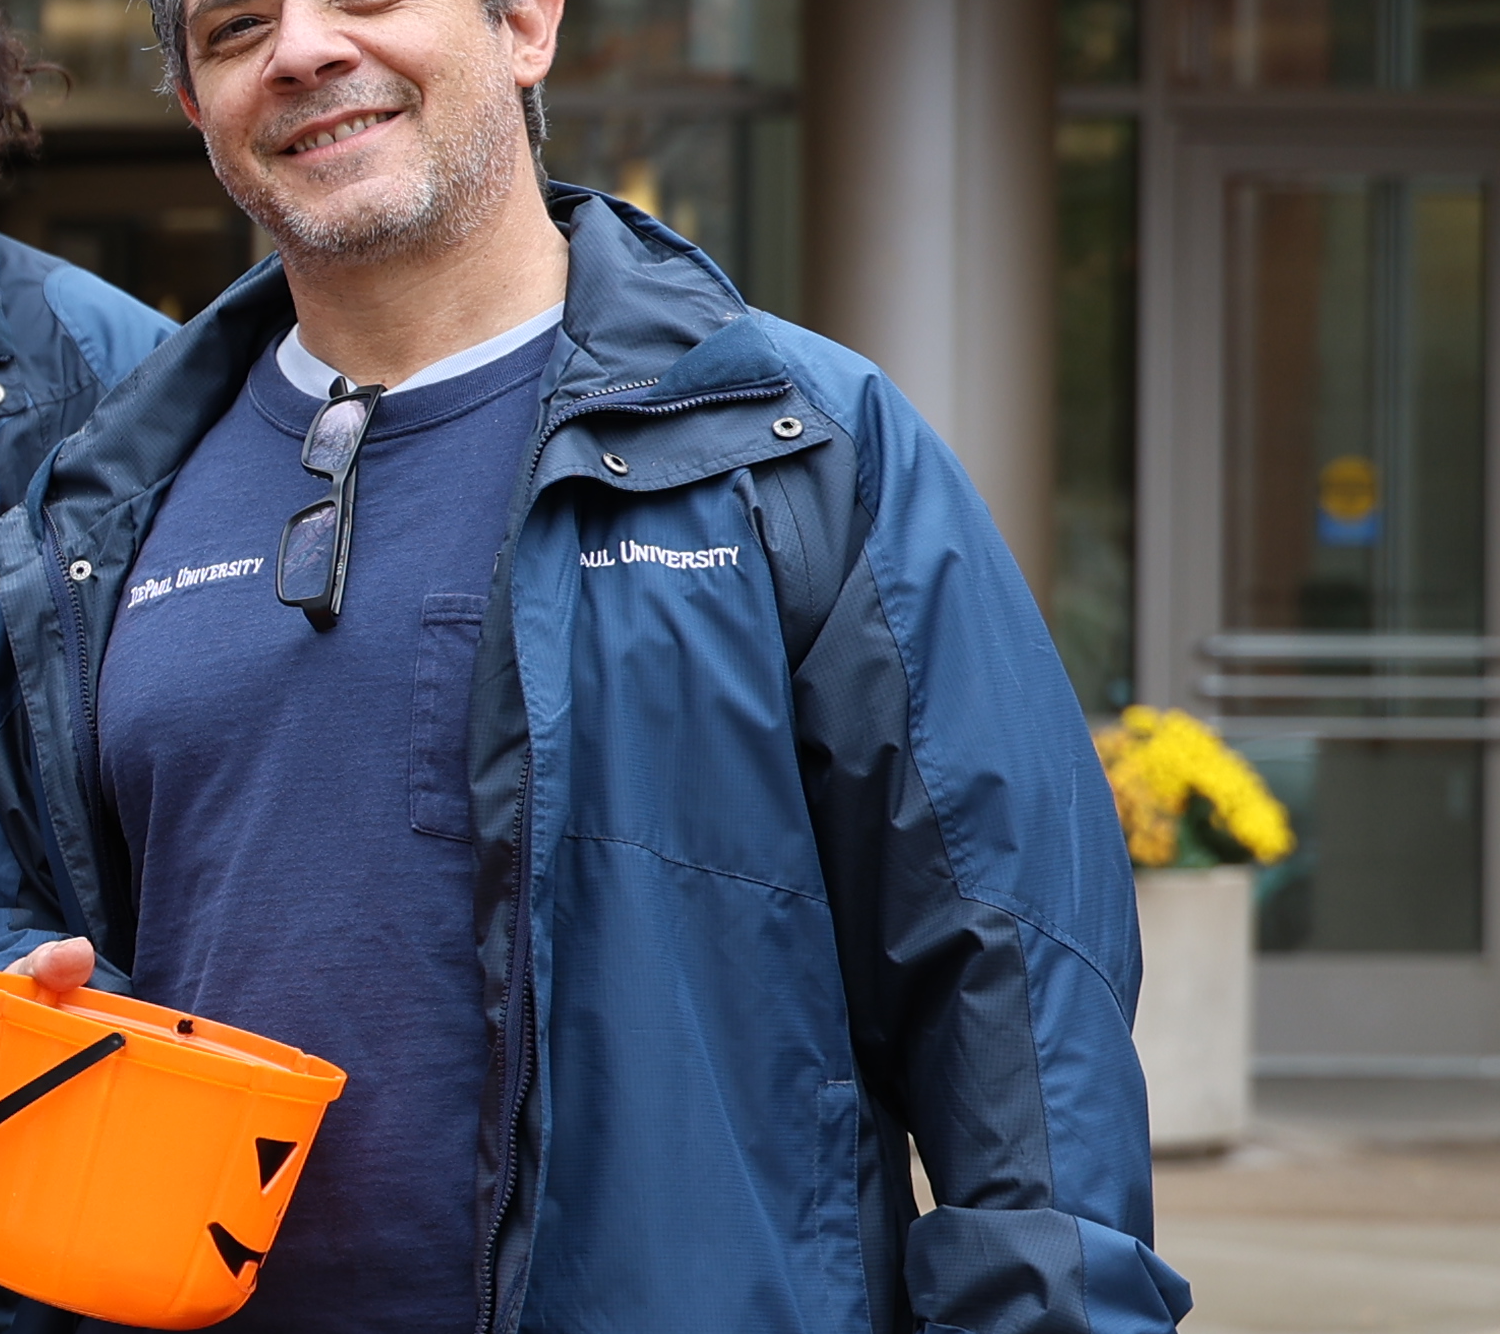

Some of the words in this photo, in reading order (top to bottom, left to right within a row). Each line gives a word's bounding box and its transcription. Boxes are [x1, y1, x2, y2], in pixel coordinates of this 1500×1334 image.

[579, 548, 616, 569] AUL
[619, 539, 740, 570] UNIVERSITY
[175, 557, 265, 589] UNIVERSITY
